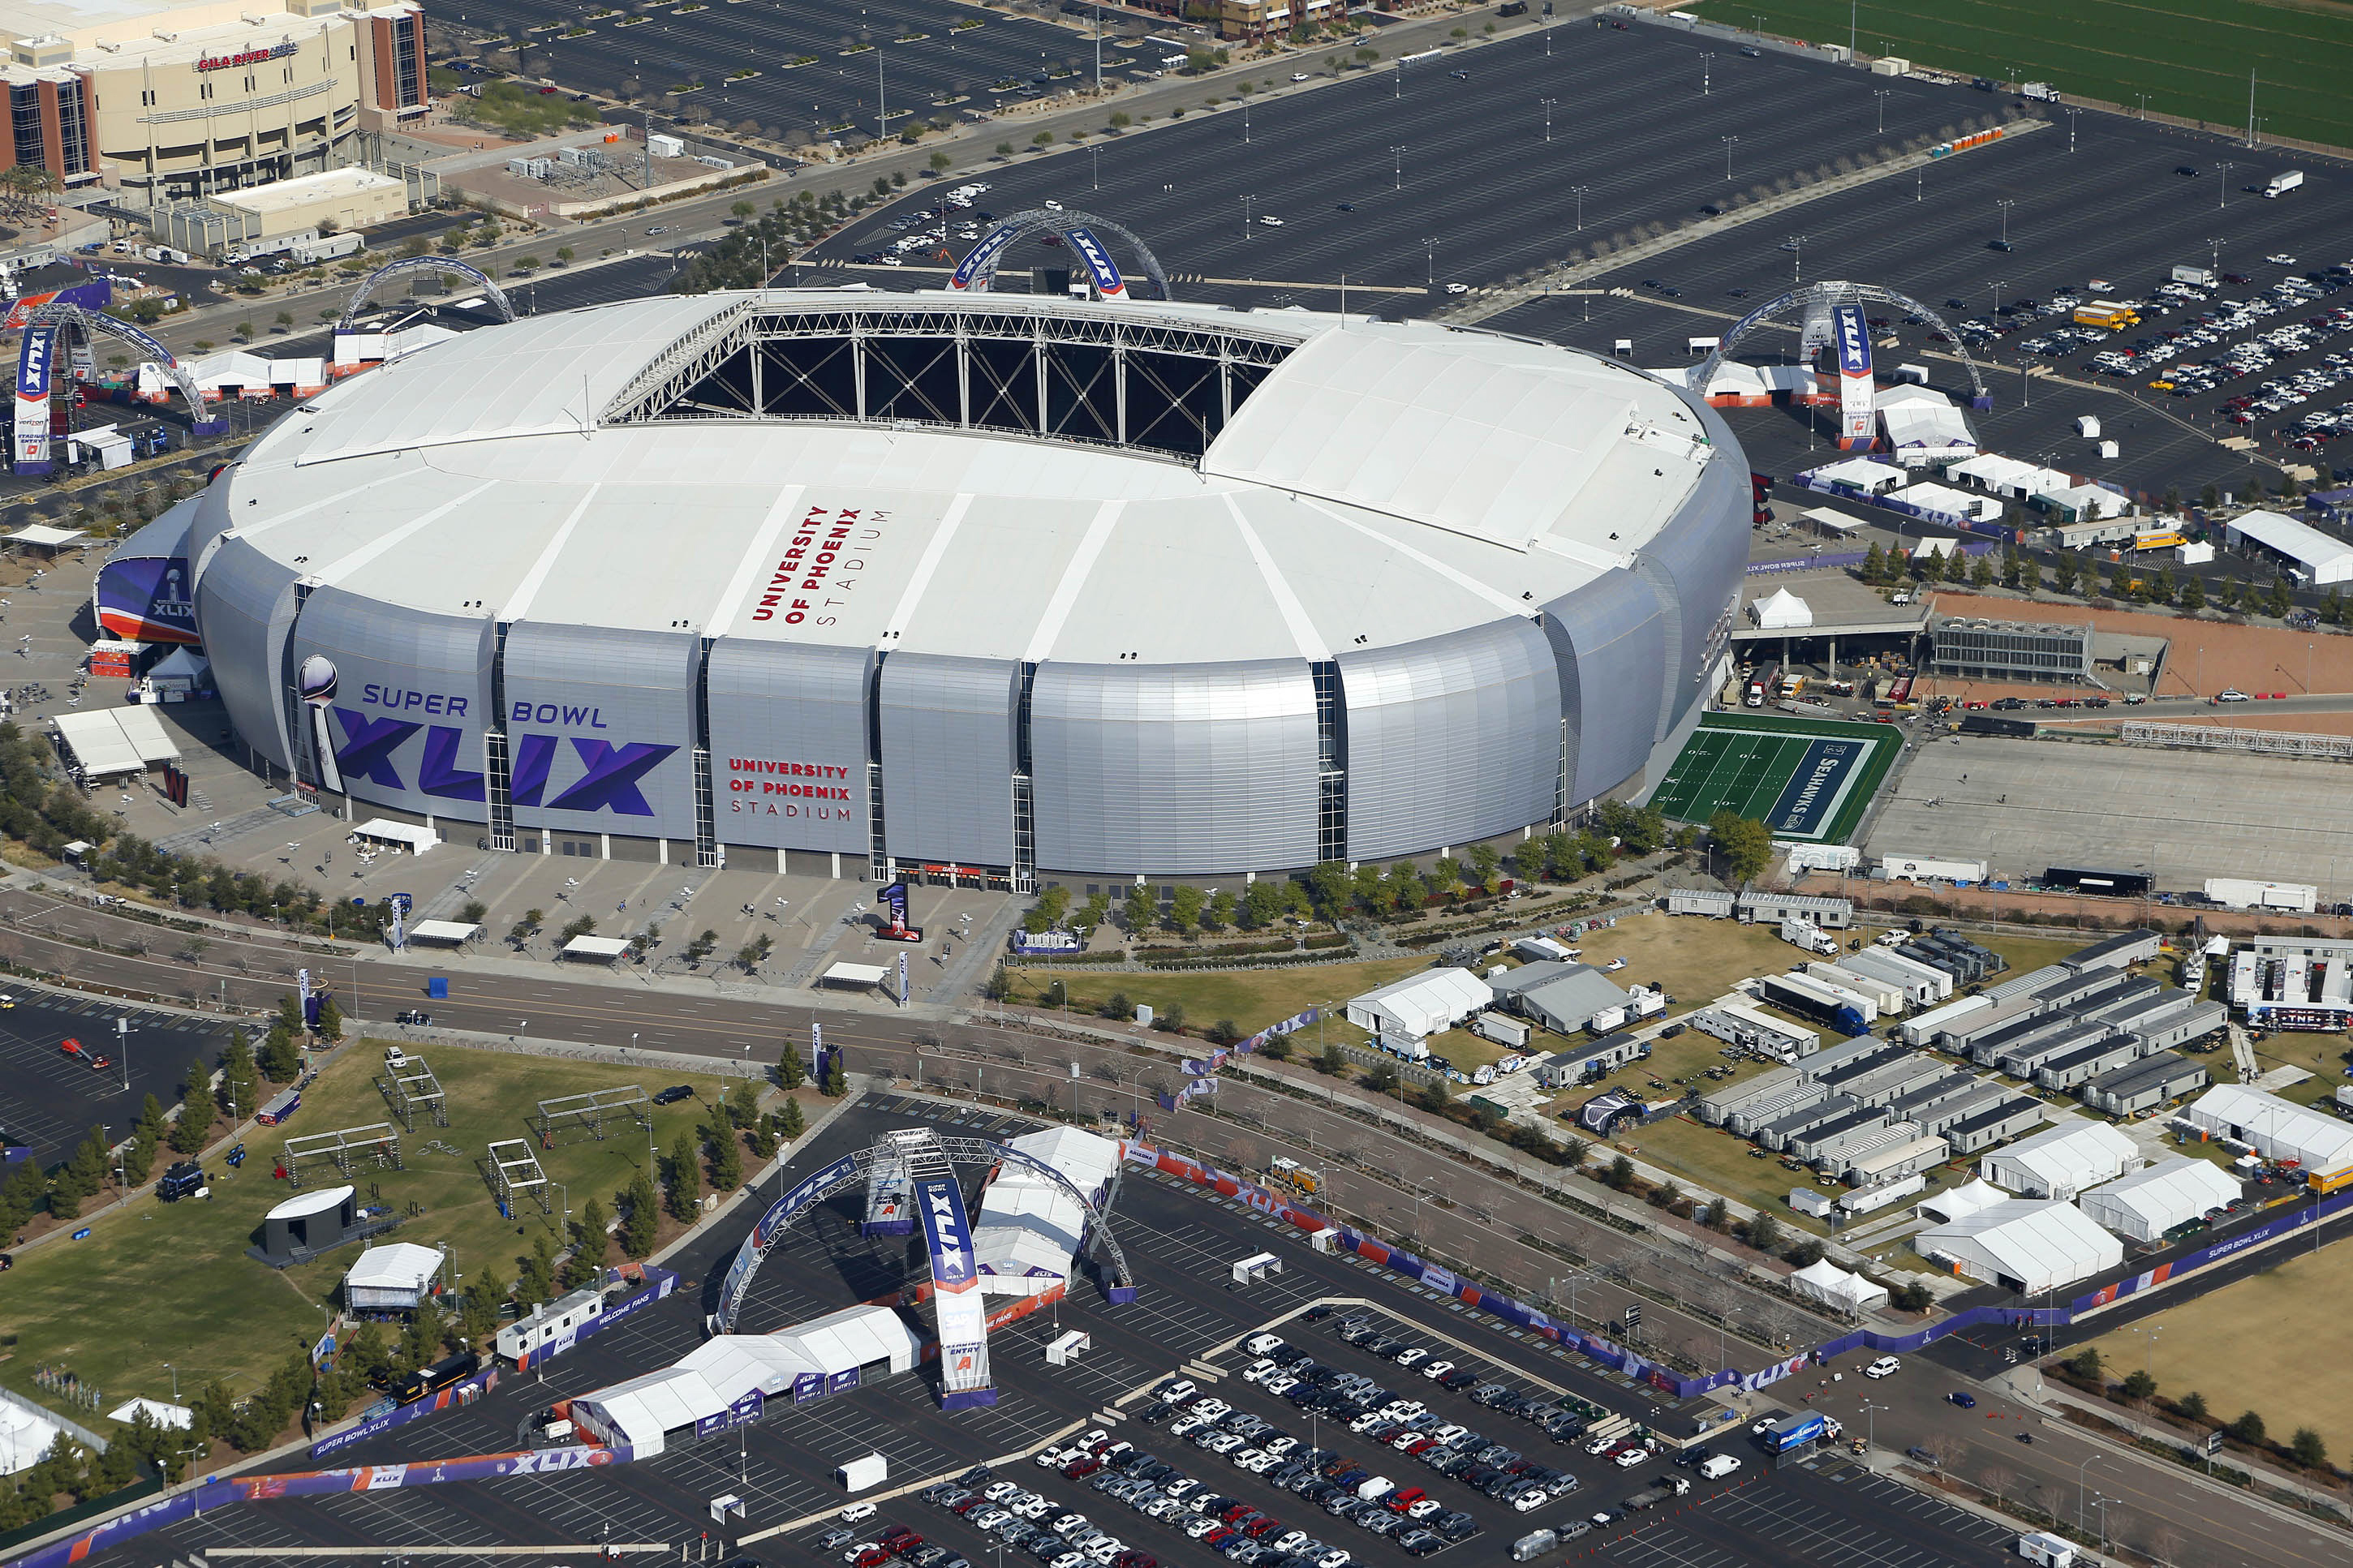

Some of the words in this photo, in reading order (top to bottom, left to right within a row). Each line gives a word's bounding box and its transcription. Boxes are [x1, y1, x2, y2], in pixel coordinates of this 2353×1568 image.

[199, 56, 231, 69] GILA
[234, 49, 269, 64] RIVER
[962, 232, 1005, 277] XLIX
[1076, 238, 1115, 283] XLIX
[1841, 313, 1863, 365] XLIX
[25, 337, 45, 389] XLIX
[19, 419, 44, 427] verizon
[751, 505, 828, 621] UNIVERSITY
[785, 598, 811, 625] OF
[801, 508, 862, 590] PHOENIX
[816, 510, 893, 626] STADIUM
[153, 604, 194, 616] XLIX
[363, 684, 468, 717] SUPER
[511, 701, 607, 728] BOWL
[332, 705, 682, 817] XLIX
[729, 758, 849, 780] UNIVERSITY
[729, 779, 755, 792] OF
[763, 782, 850, 801] PHOENIX
[1792, 758, 1839, 814] SEAHAWKS
[731, 800, 850, 822] STADIUM
[2288, 1015, 2315, 1023] TNF
[1129, 1149, 1153, 1161] ARIZONA
[877, 1181, 899, 1190] SAP
[767, 1166, 841, 1232] XLIX
[882, 1205, 895, 1215] A
[1232, 1186, 1292, 1221] XLIX
[928, 1192, 964, 1274] XLIX
[2209, 1244, 2233, 1259] SUPER
[2233, 1237, 2252, 1250] BOWL
[2252, 1229, 2270, 1241] XLIX
[1426, 1274, 1449, 1288] ARIZONA
[599, 1304, 630, 1325] WELCOME
[632, 1293, 650, 1308] FANS
[996, 1311, 1013, 1325] FANS
[557, 1334, 574, 1347] XLIX
[950, 1347, 980, 1355] ENTRY
[956, 1356, 971, 1371] A
[798, 1391, 816, 1402] ENTRY
[834, 1381, 851, 1392] ENTRY
[738, 1394, 756, 1405] XLIX
[736, 1413, 753, 1423] ENTRY
[316, 1437, 343, 1455] SUPER
[344, 1428, 369, 1442] BOWL
[369, 1418, 390, 1433] XLIX
[701, 1427, 716, 1435] ENTRY
[1779, 1433, 1797, 1445] BUD
[1798, 1424, 1820, 1437] LIGHT
[509, 1449, 602, 1476] XLIX
[374, 1475, 400, 1483] XLIX
